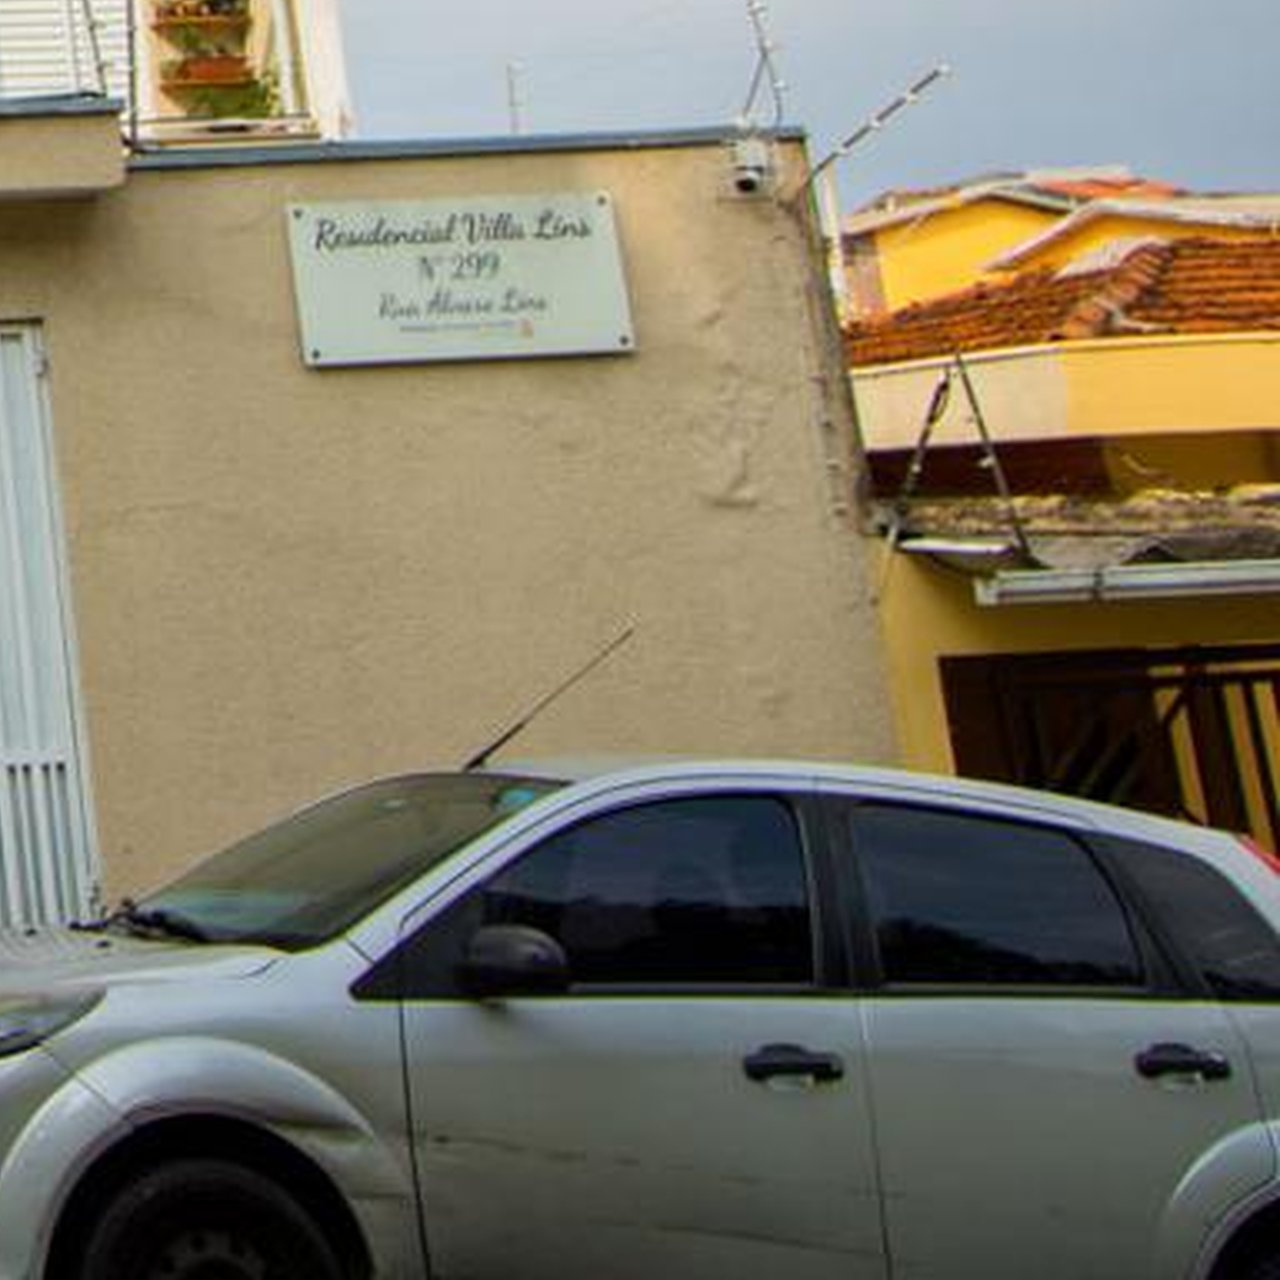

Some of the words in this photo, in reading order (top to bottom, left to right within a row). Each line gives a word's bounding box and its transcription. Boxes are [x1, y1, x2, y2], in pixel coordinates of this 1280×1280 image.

[314, 214, 458, 251] Residencial
[461, 212, 525, 245] Villa
[533, 208, 592, 240] Lins
[450, 251, 501, 281] 299
[378, 292, 419, 320] Rua
